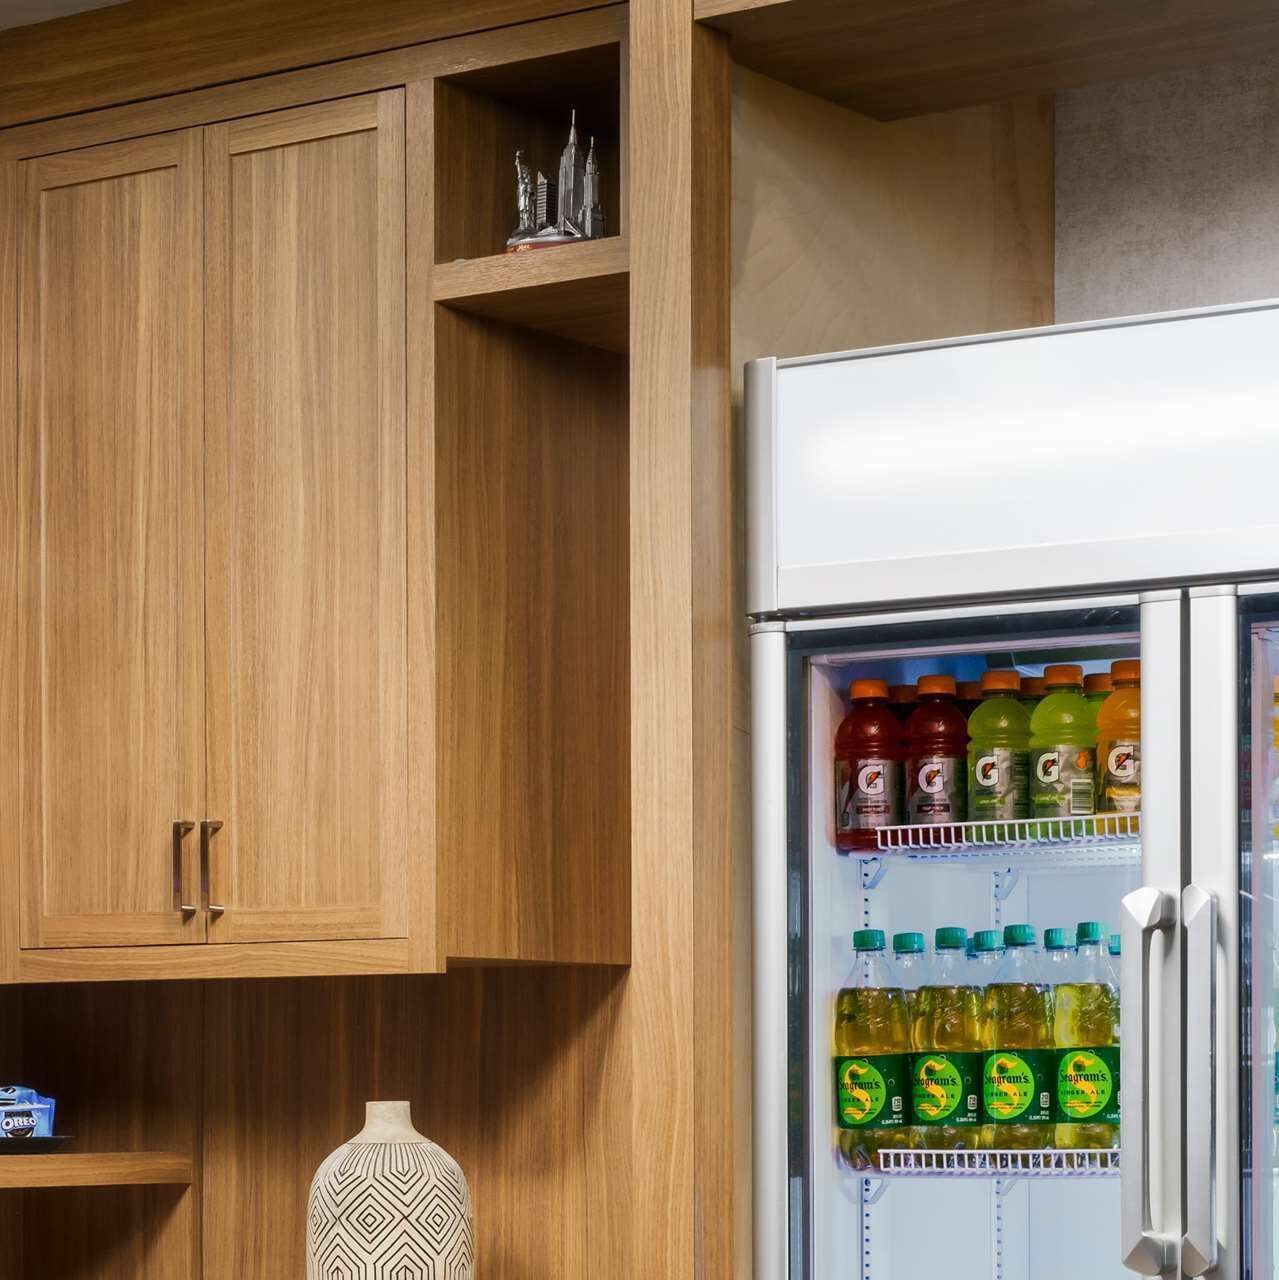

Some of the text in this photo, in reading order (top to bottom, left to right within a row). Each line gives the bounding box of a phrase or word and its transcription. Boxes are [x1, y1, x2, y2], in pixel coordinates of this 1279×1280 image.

[976, 755, 999, 787] G
[1037, 751, 1060, 784] G
[1108, 745, 1135, 777] G
[858, 764, 885, 795] G
[918, 762, 945, 794] G
[1, 1116, 37, 1131] OREO
